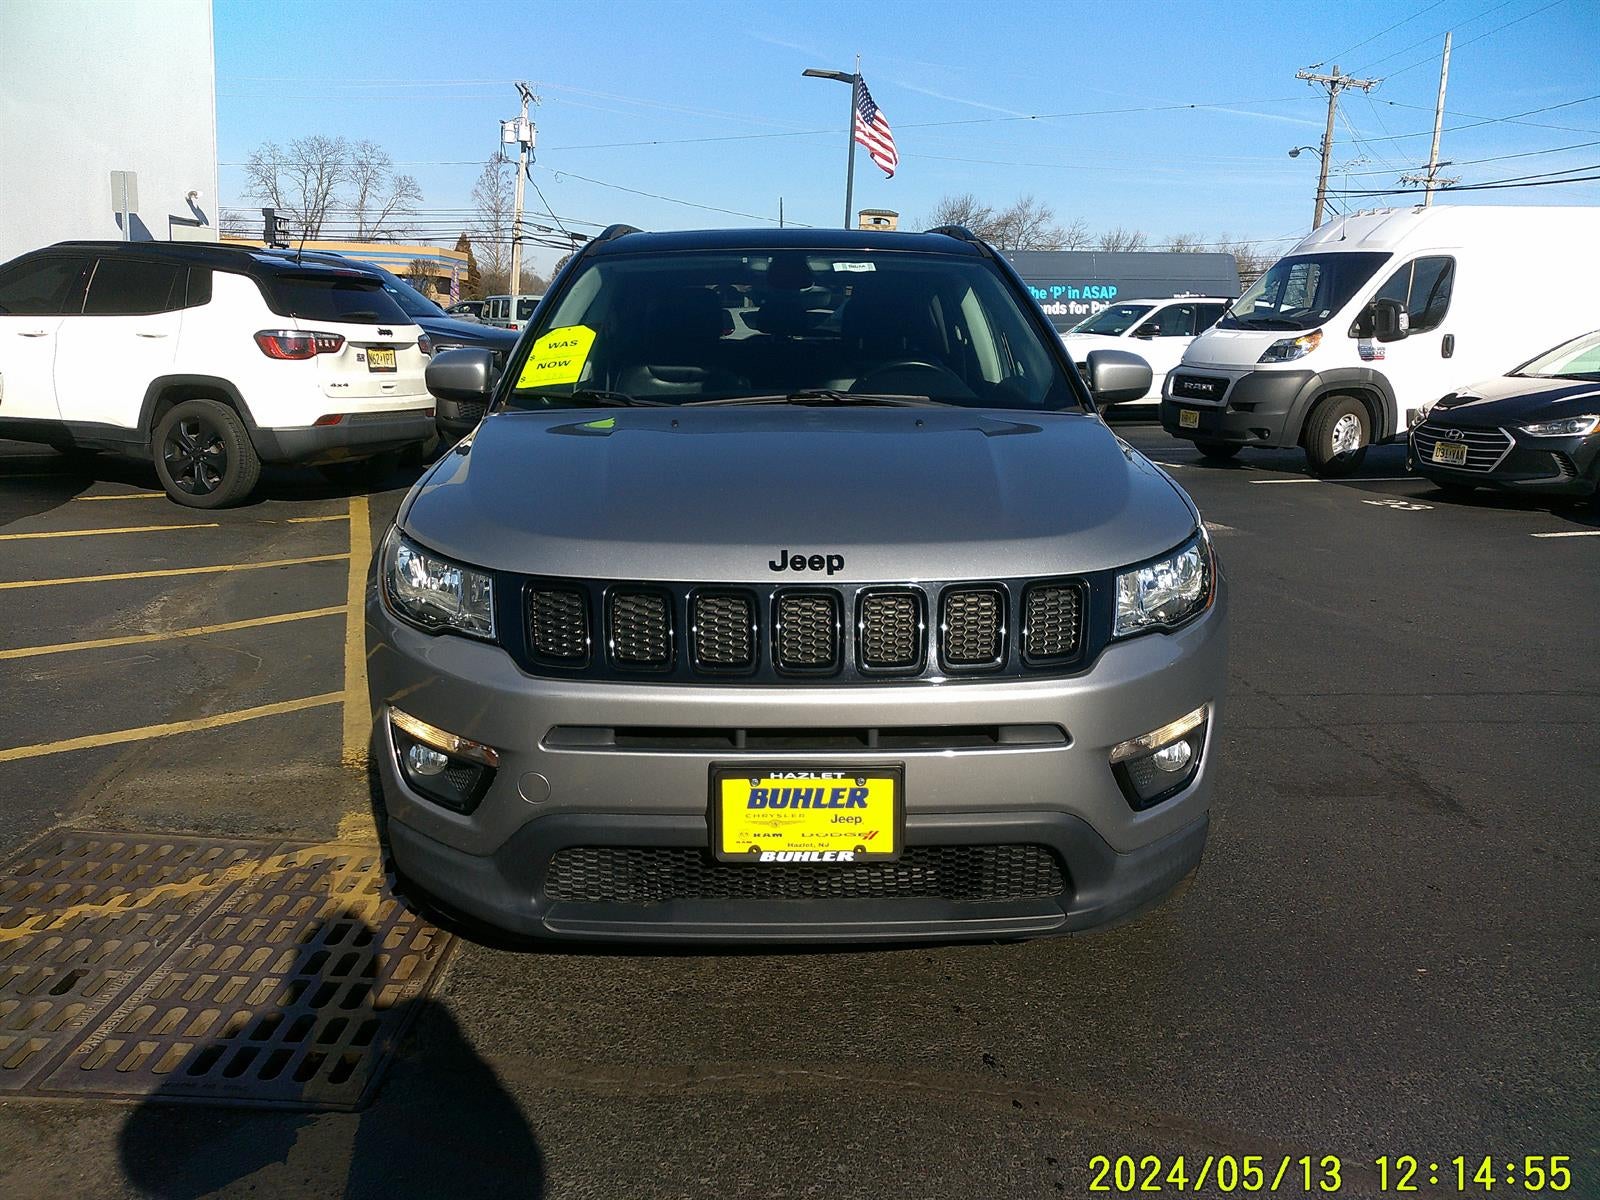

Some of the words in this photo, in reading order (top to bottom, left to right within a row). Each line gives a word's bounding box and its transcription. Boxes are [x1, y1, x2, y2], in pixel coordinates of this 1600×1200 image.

[1067, 286, 1080, 299] in
[1082, 286, 1117, 299] ASAP
[1040, 301, 1067, 315] nds
[1068, 301, 1089, 315] for
[1090, 301, 1112, 315] Pri
[548, 340, 579, 349] WAS
[536, 360, 572, 370] NOW
[769, 550, 844, 575] Jeep
[770, 772, 846, 780] HAZLET
[747, 787, 869, 809] BUHLER
[830, 814, 862, 825] Jeep
[759, 851, 855, 862] BUHLER
